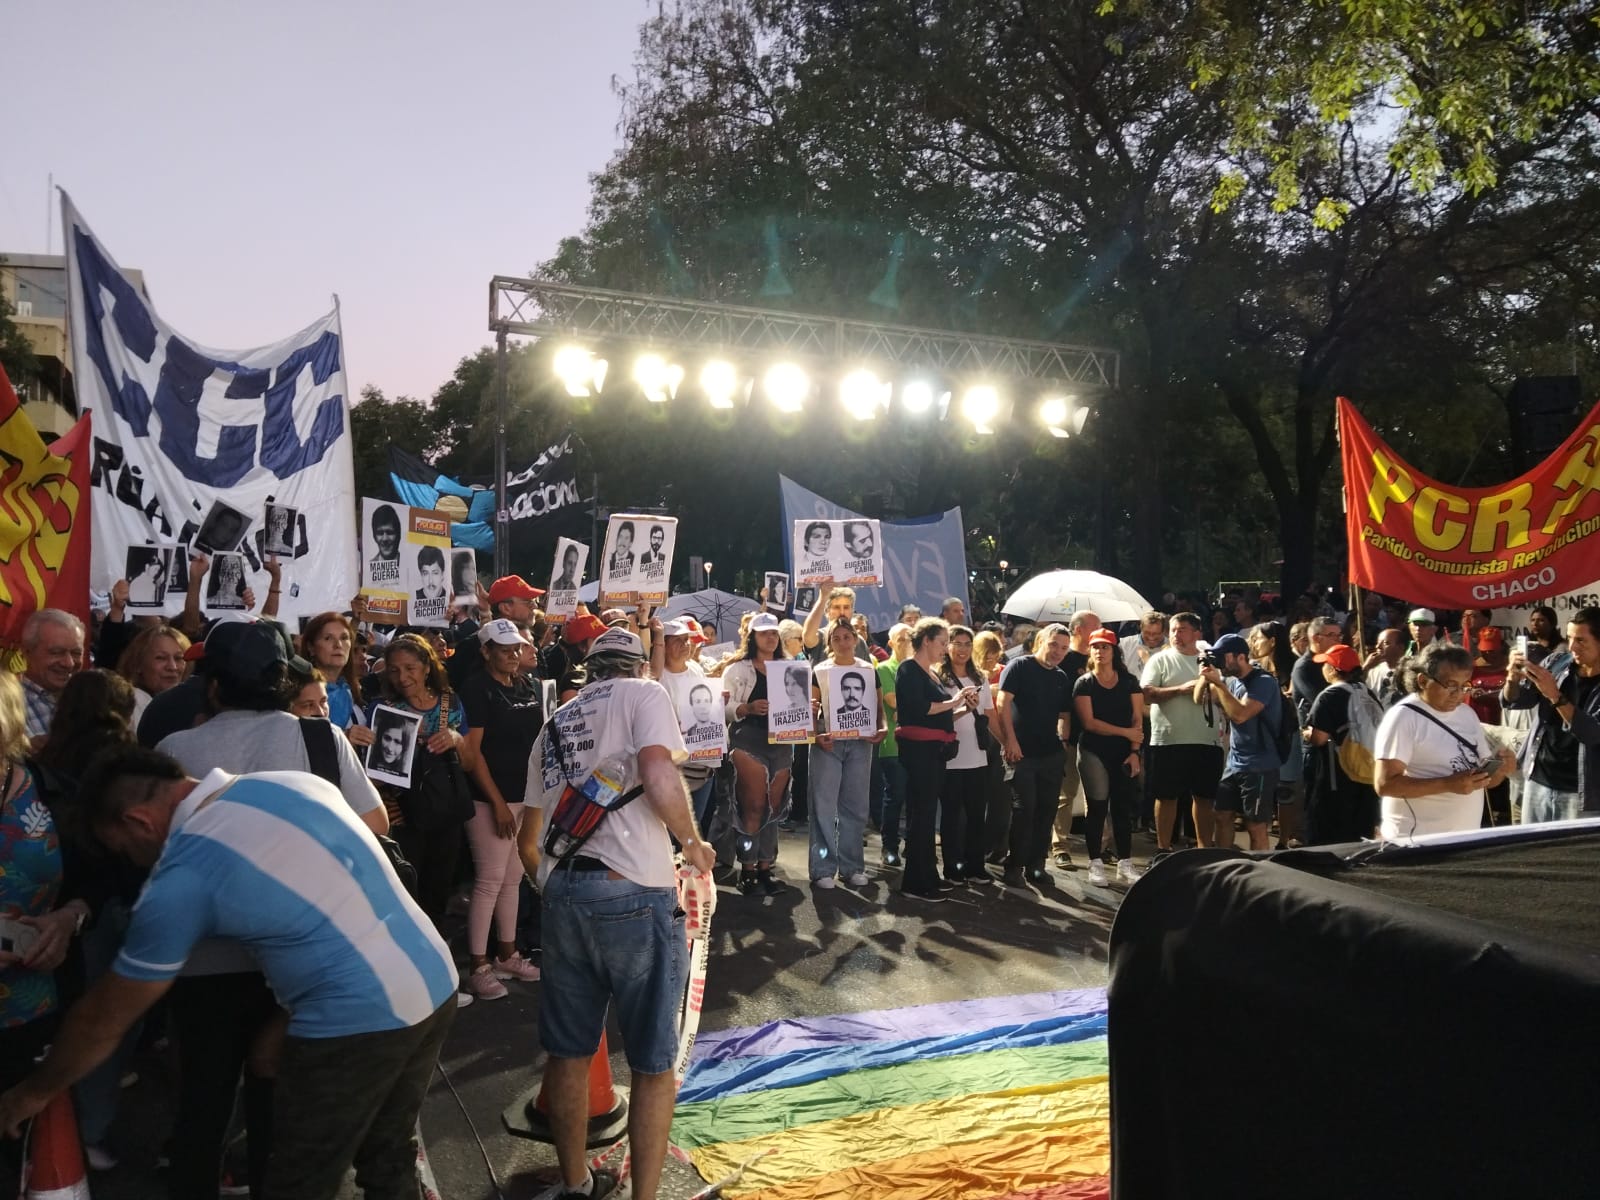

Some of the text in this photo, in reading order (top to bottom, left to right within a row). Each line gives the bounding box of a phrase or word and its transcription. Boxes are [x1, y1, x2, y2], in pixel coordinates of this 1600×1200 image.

[1368, 447, 1534, 553] PCR
[1361, 524, 1412, 561] Partido
[1415, 551, 1508, 576] Comunista
[370, 561, 400, 572] MANUEL
[800, 565, 832, 575] MANFREDI
[844, 559, 873, 569] EUGENIO
[372, 569, 400, 581] GUERRA
[1472, 566, 1556, 601] CHACO
[413, 597, 446, 610] ARMANDO
[415, 606, 447, 618] RICCIOTTI
[774, 711, 810, 727] IRAZUSTA
[837, 709, 871, 722] ENRIQUE
[696, 723, 724, 734] RODOLFO
[839, 718, 871, 730] RUSCONI
[684, 732, 724, 745] WILLEMBERG
